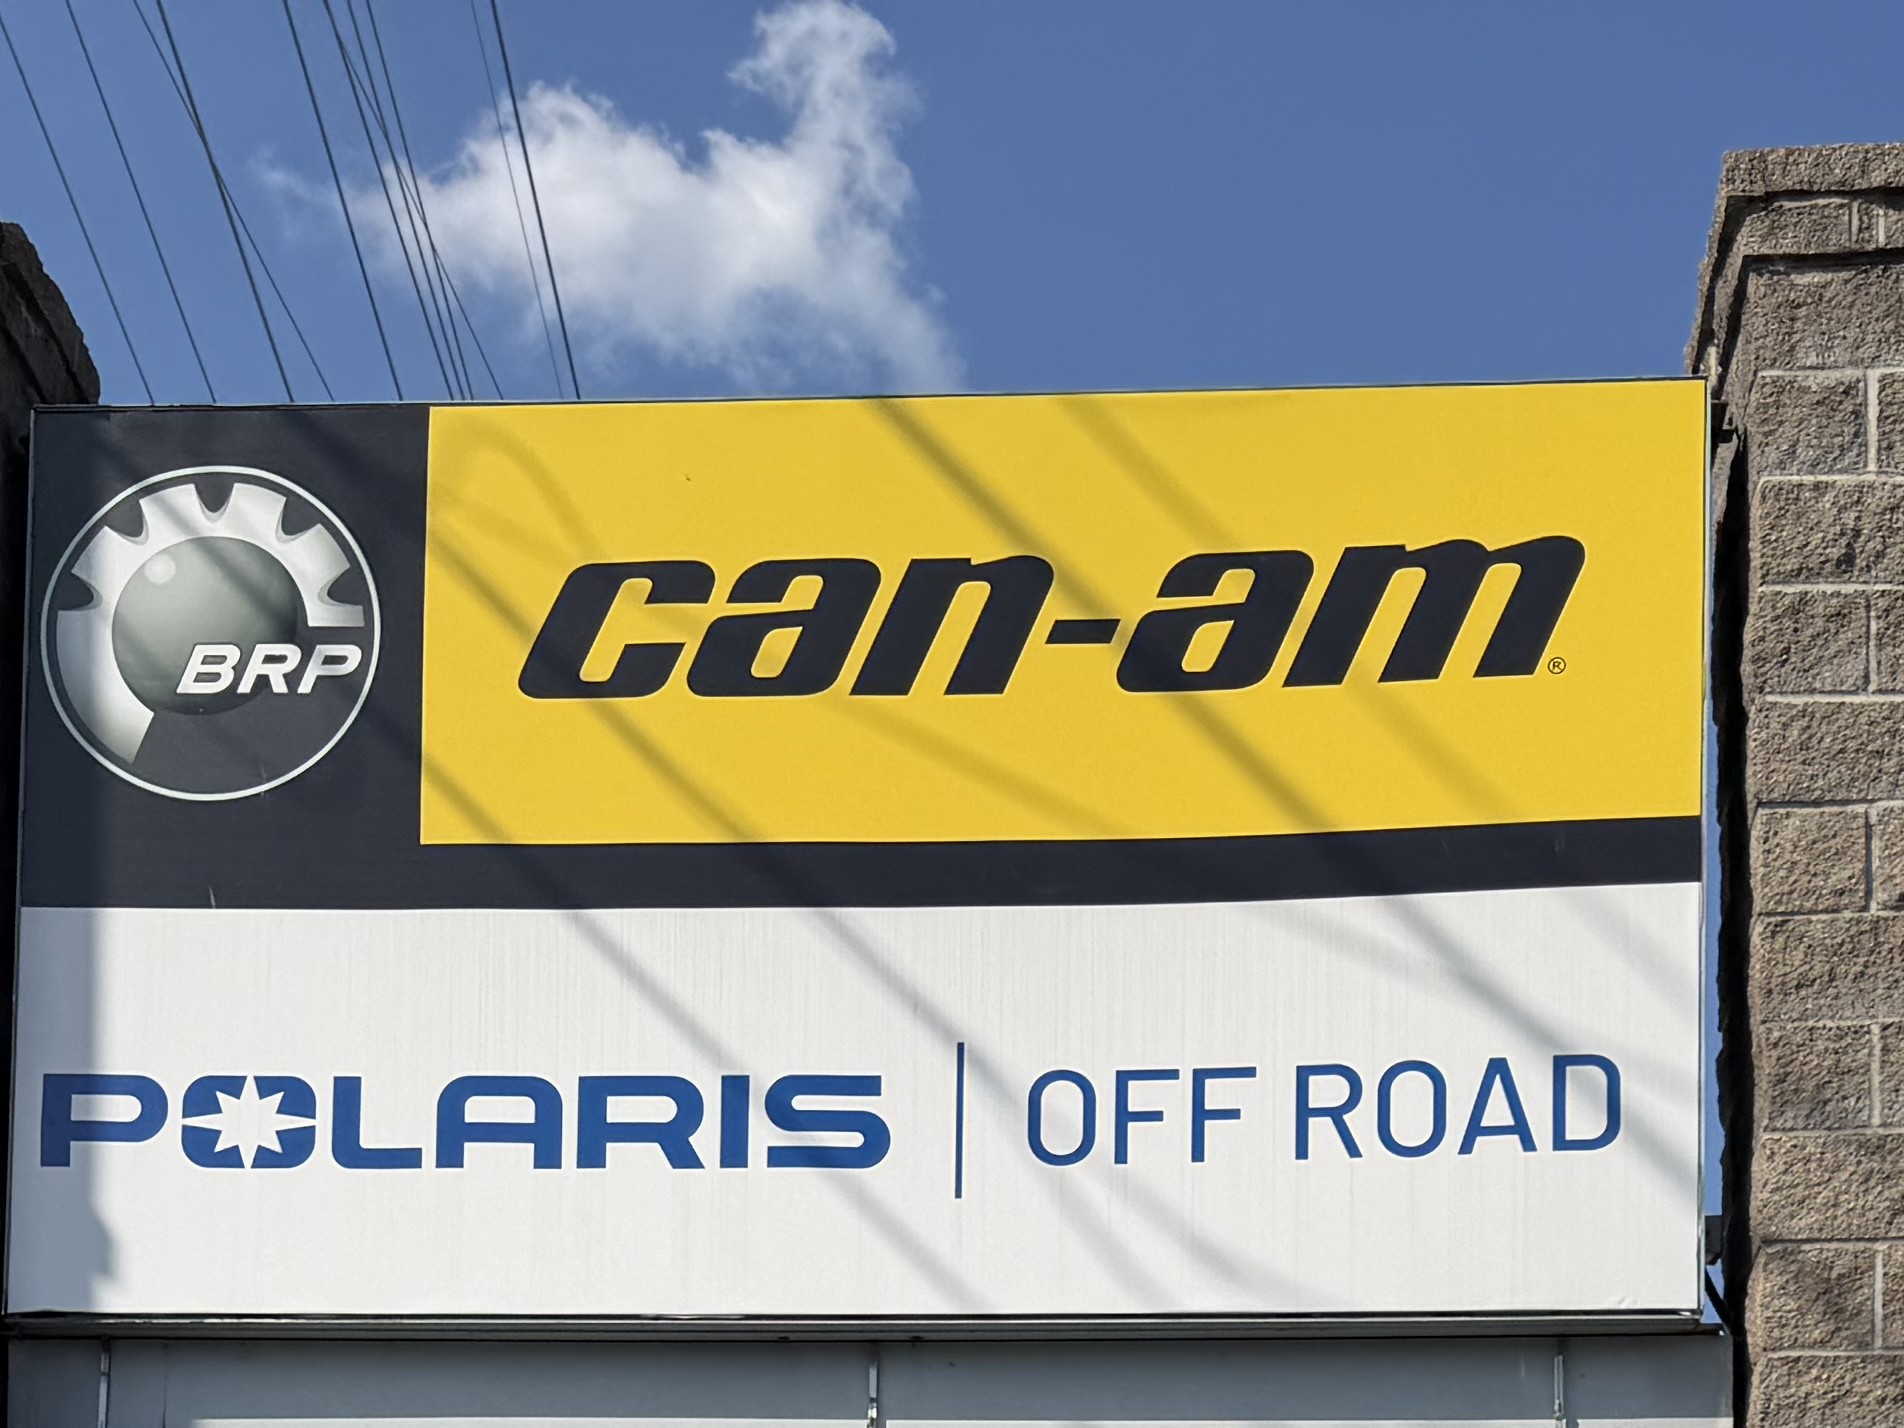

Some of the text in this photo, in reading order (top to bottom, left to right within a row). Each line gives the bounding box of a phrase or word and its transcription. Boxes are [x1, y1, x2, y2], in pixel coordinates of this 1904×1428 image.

[174, 643, 364, 695] BRP
[518, 535, 1586, 699] can-am
[40, 1053, 1622, 1169] POLARIS OFF ROAD
